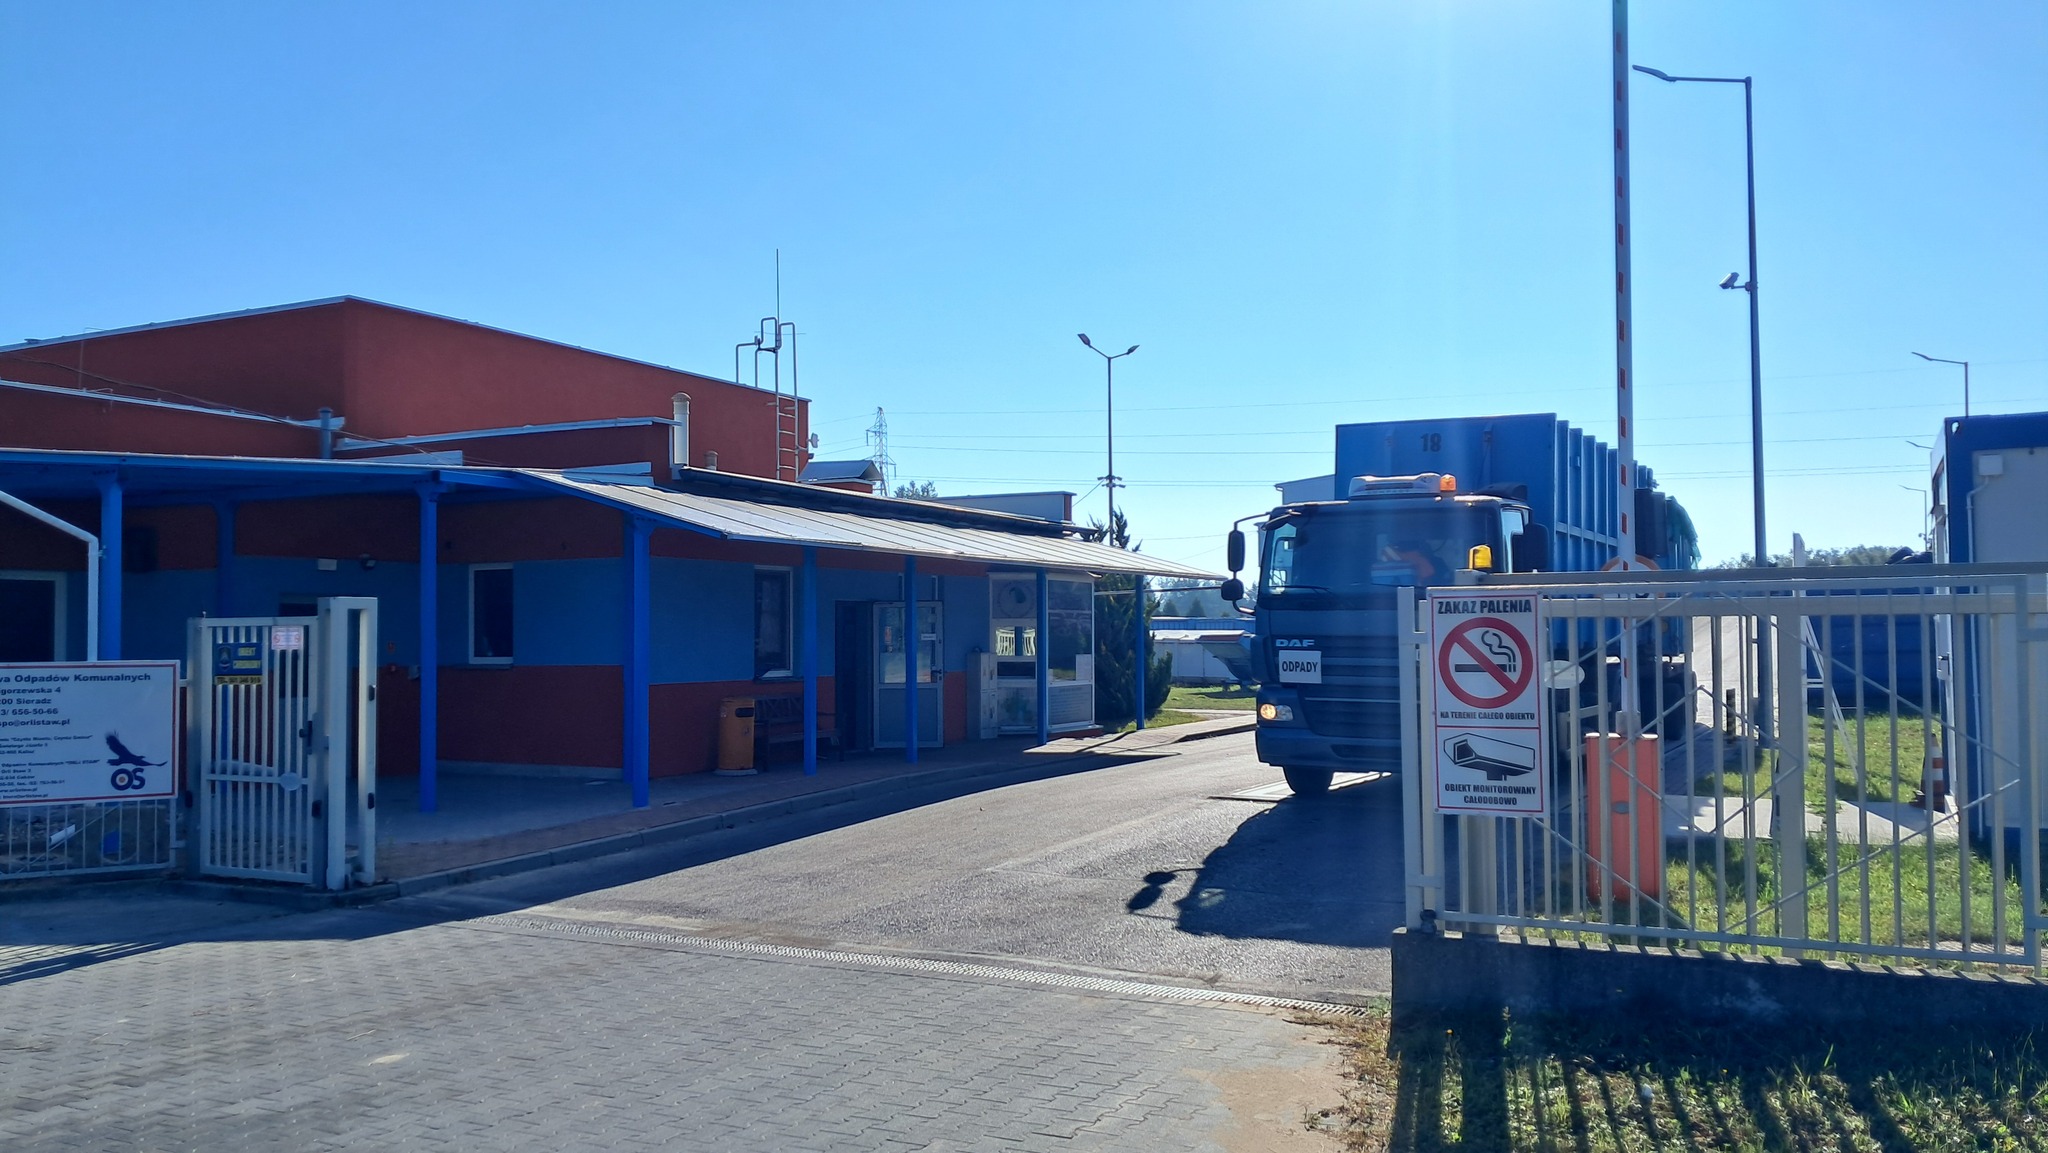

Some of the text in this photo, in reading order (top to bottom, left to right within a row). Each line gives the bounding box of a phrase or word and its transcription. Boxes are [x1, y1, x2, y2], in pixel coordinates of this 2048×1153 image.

[1420, 432, 1442, 452] 18
[1438, 599, 1532, 614] ZAKAZ PALENIA
[1276, 639, 1315, 647] DAF
[1282, 661, 1318, 672] ODPADY
[14, 674, 70, 684] Odpadów
[74, 673, 151, 682] Komunalnych
[1440, 711, 1449, 719] NA
[1505, 712, 1535, 720] OBIEKTU
[110, 767, 146, 791] OS
[1445, 783, 1536, 794] OBIEKT MONITOROWANY
